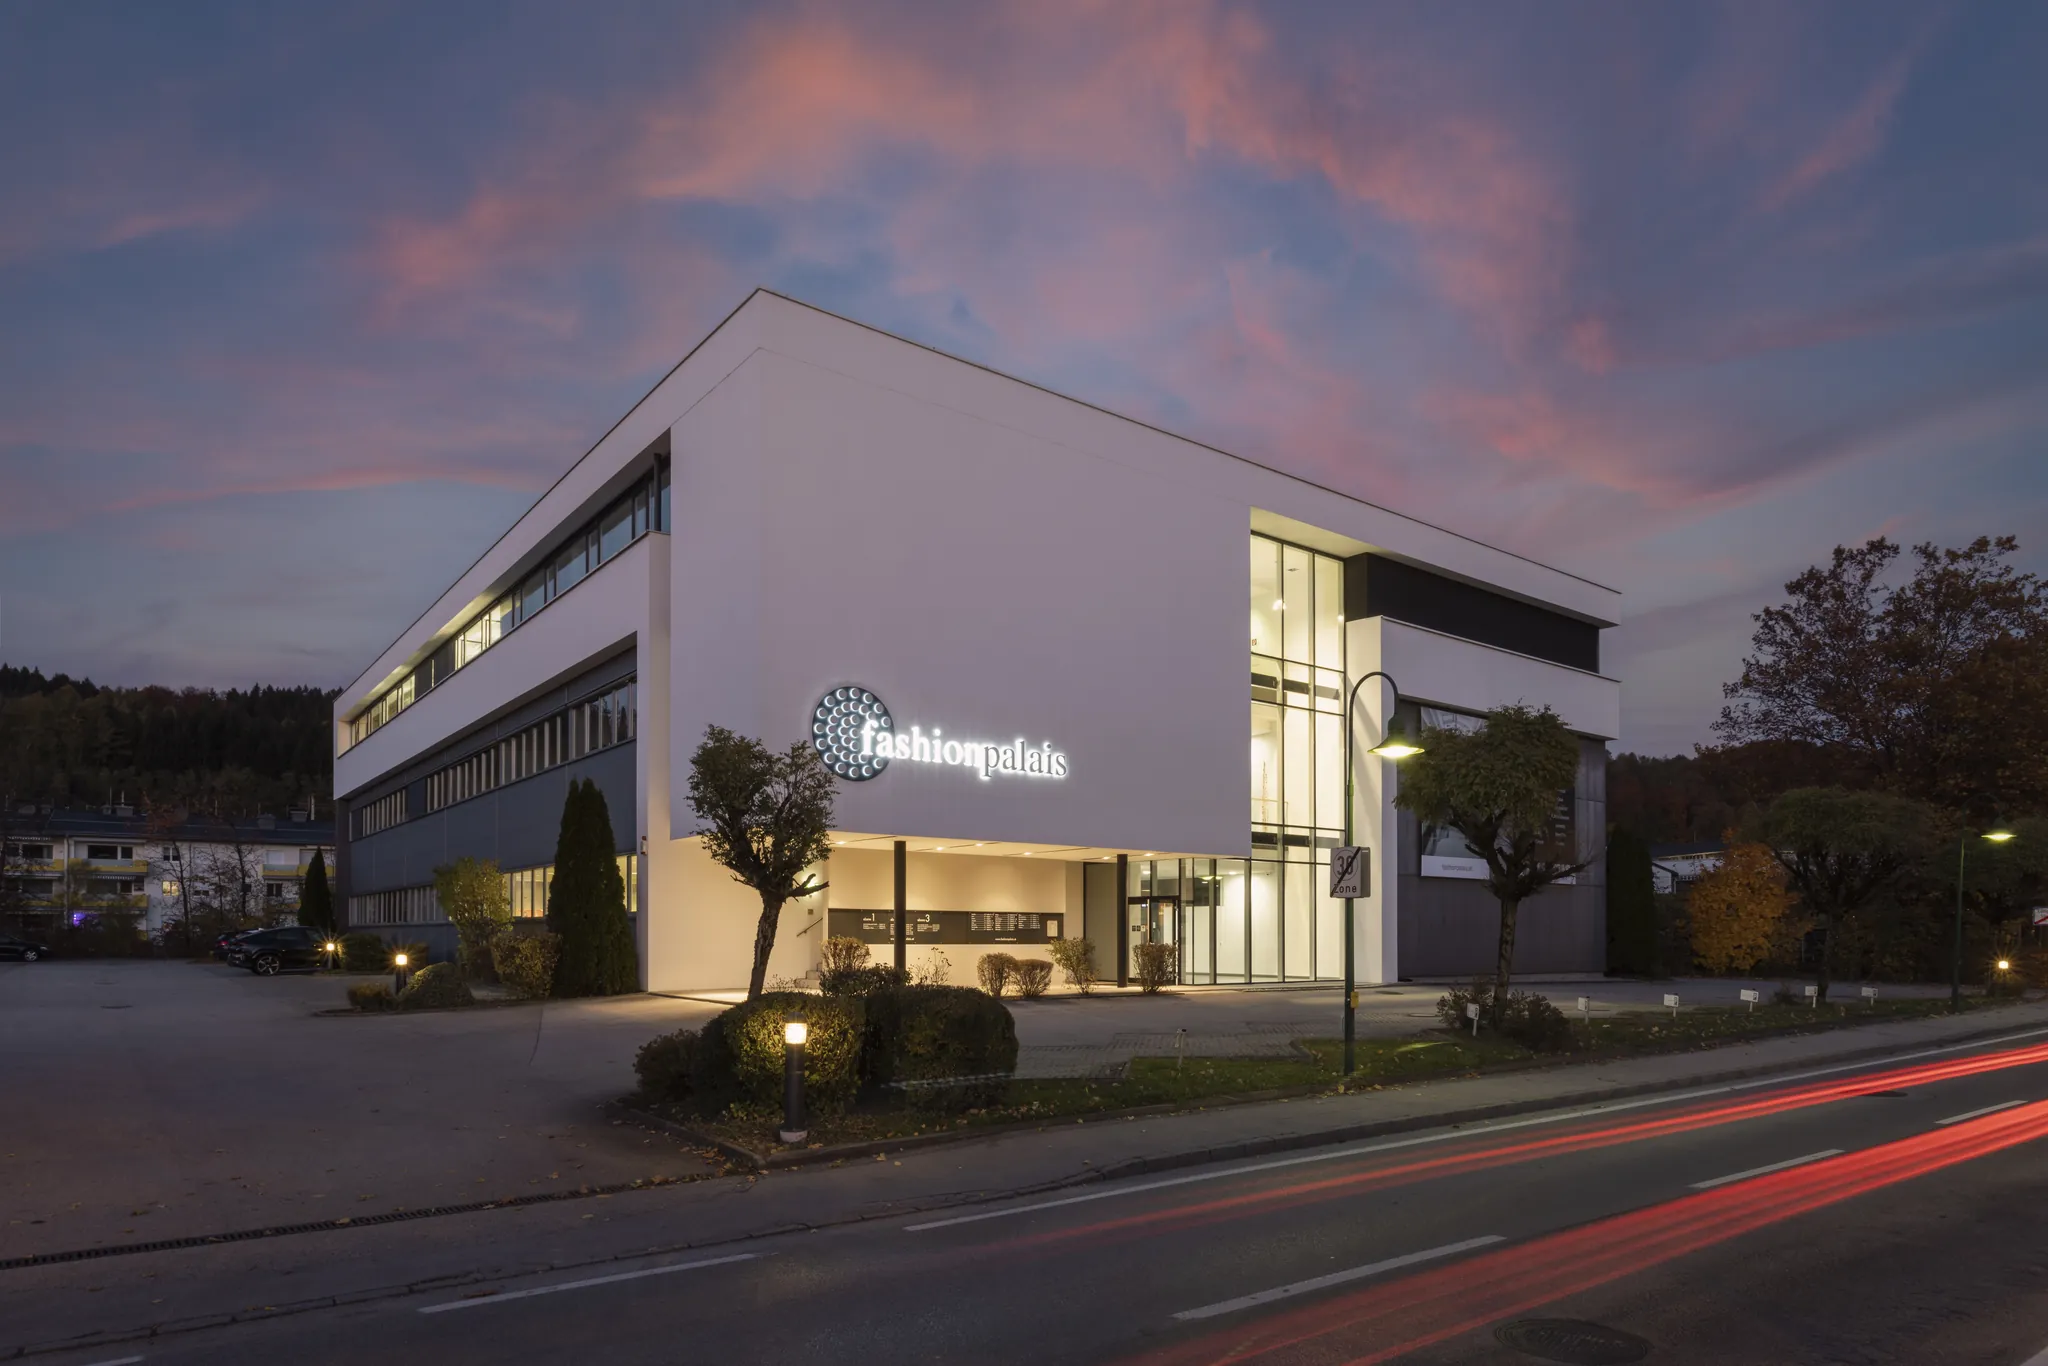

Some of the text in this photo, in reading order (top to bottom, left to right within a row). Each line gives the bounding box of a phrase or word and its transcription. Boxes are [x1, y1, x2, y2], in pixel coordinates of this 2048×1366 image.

[860, 719, 1067, 778] fashionpalais
[1337, 855, 1354, 876] 30
[1333, 883, 1357, 894] Zone
